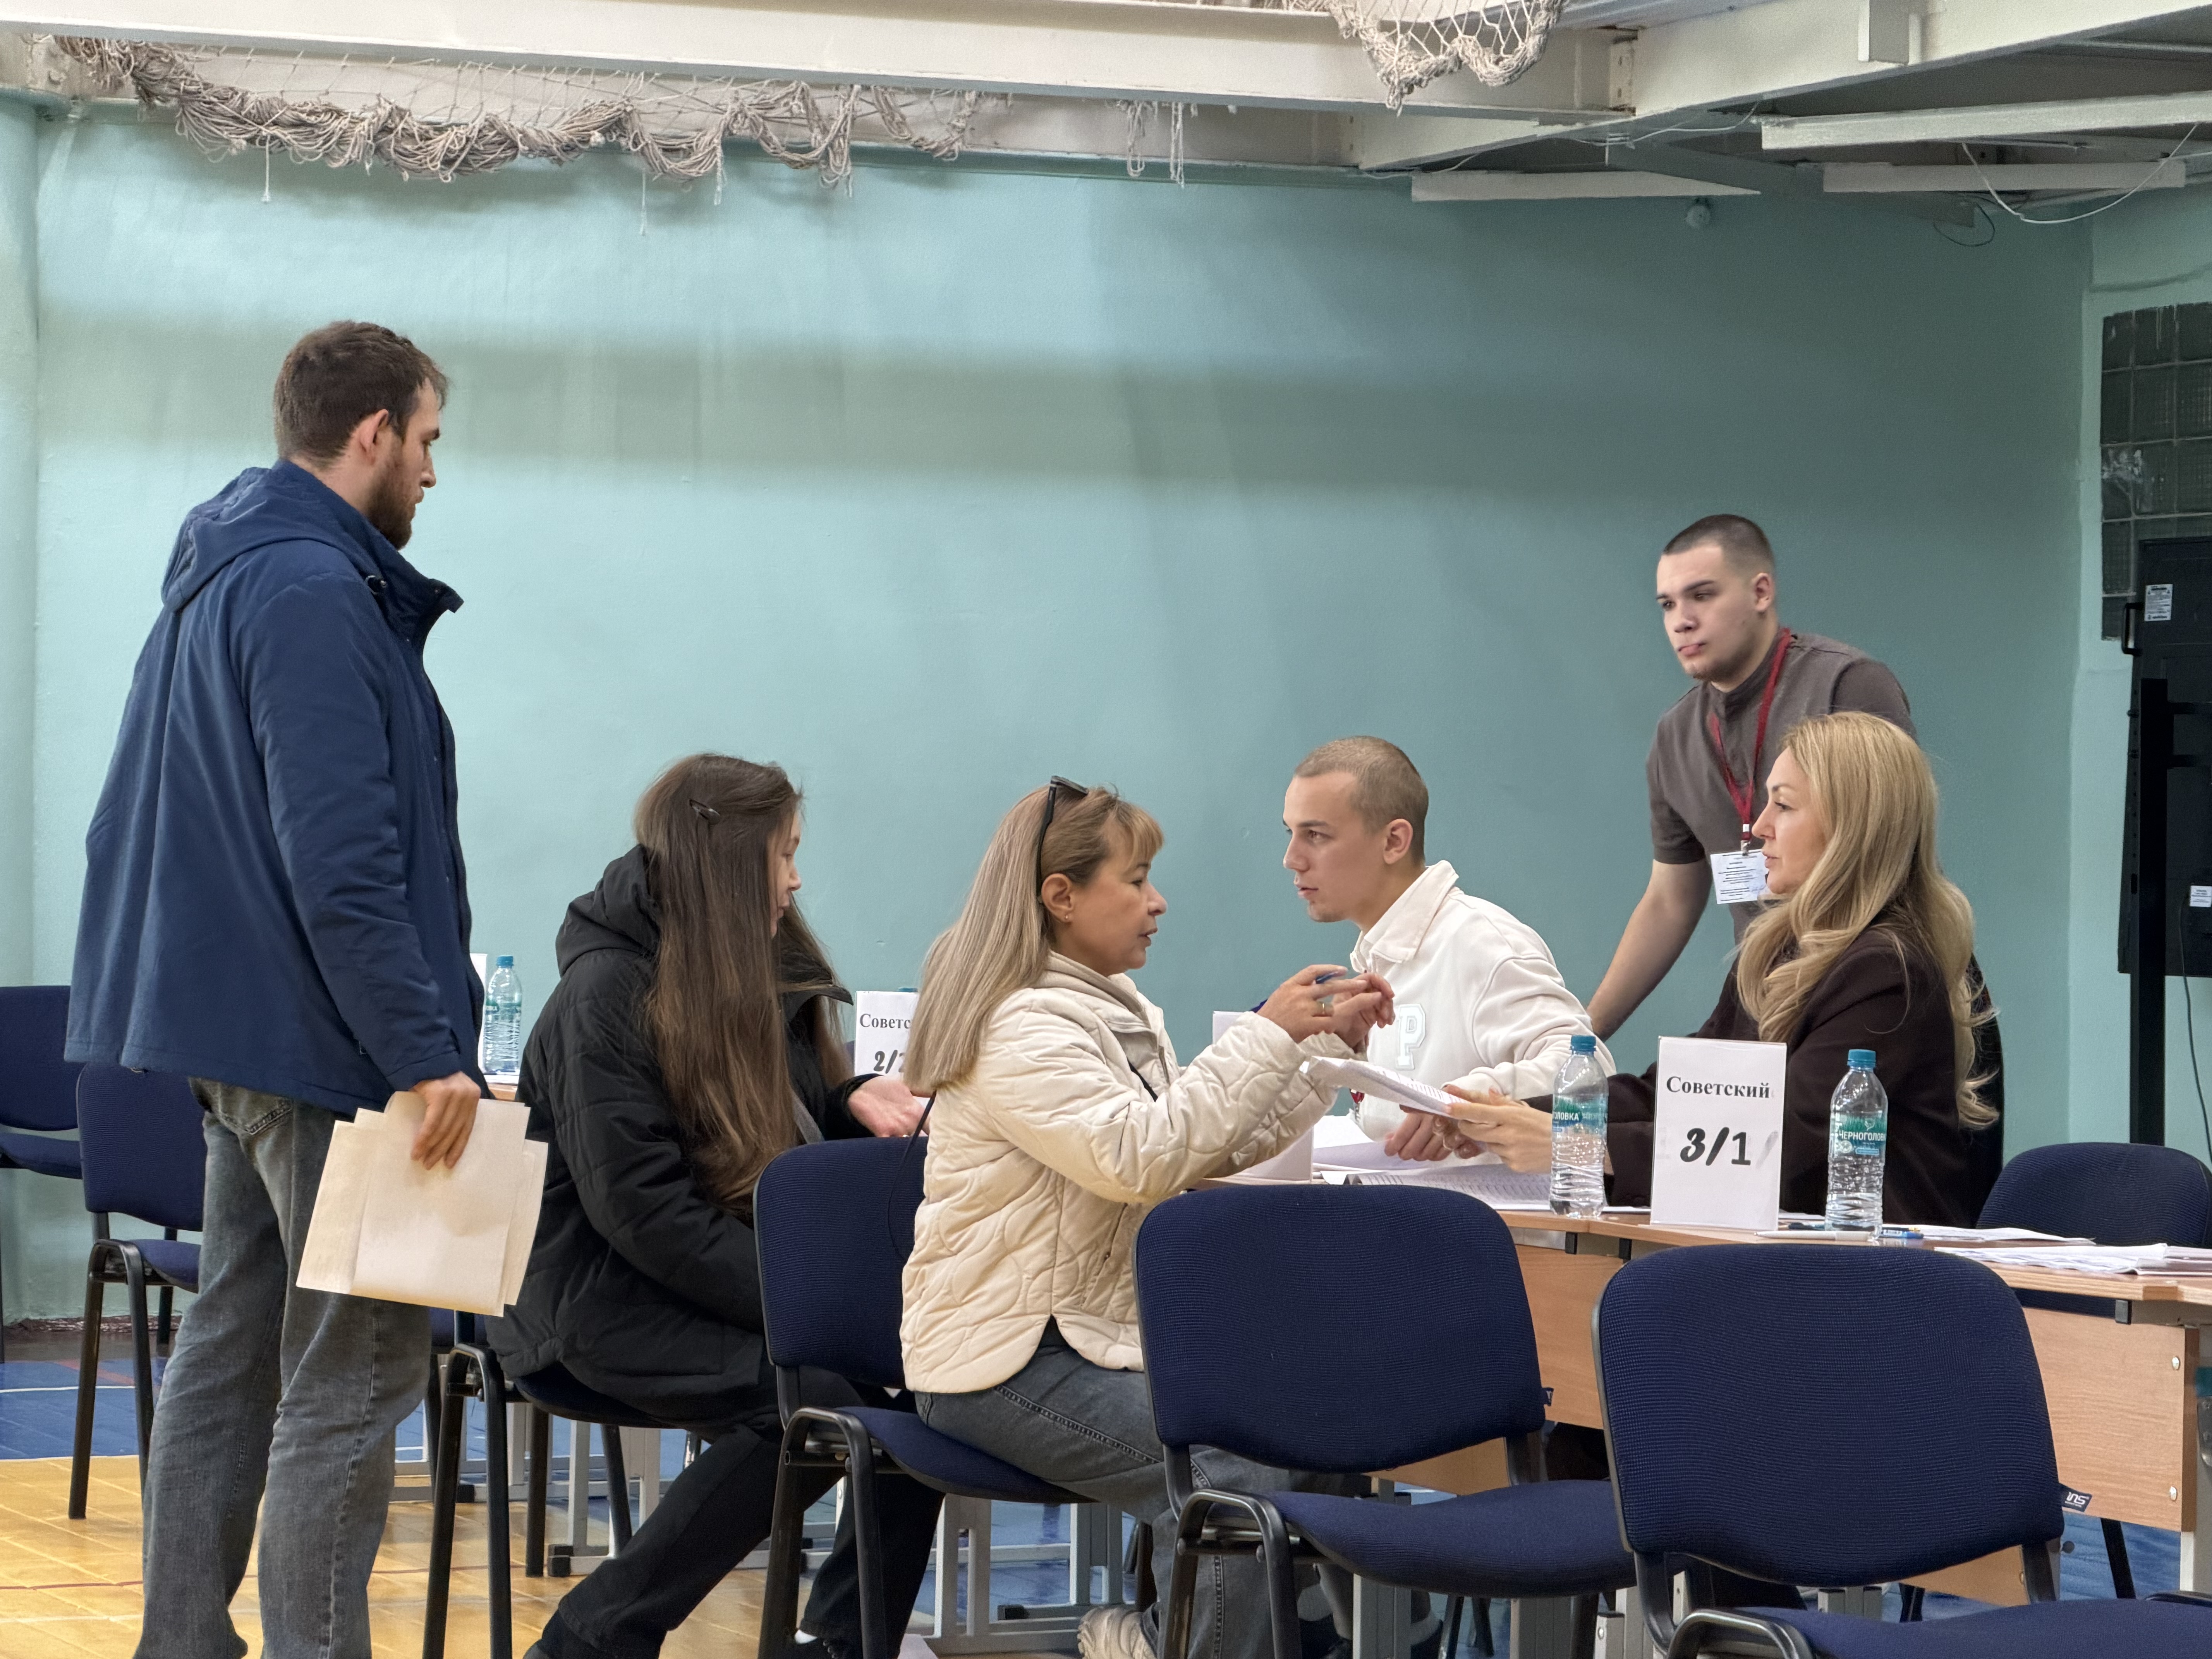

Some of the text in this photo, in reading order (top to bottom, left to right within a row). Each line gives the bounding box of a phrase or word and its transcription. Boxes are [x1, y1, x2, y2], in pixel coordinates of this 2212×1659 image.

[860, 1013, 911, 1029] Советс
[1396, 1004, 1426, 1070] P
[1666, 1076, 1770, 1098] Советский
[1680, 1127, 1751, 1166] 3/1
